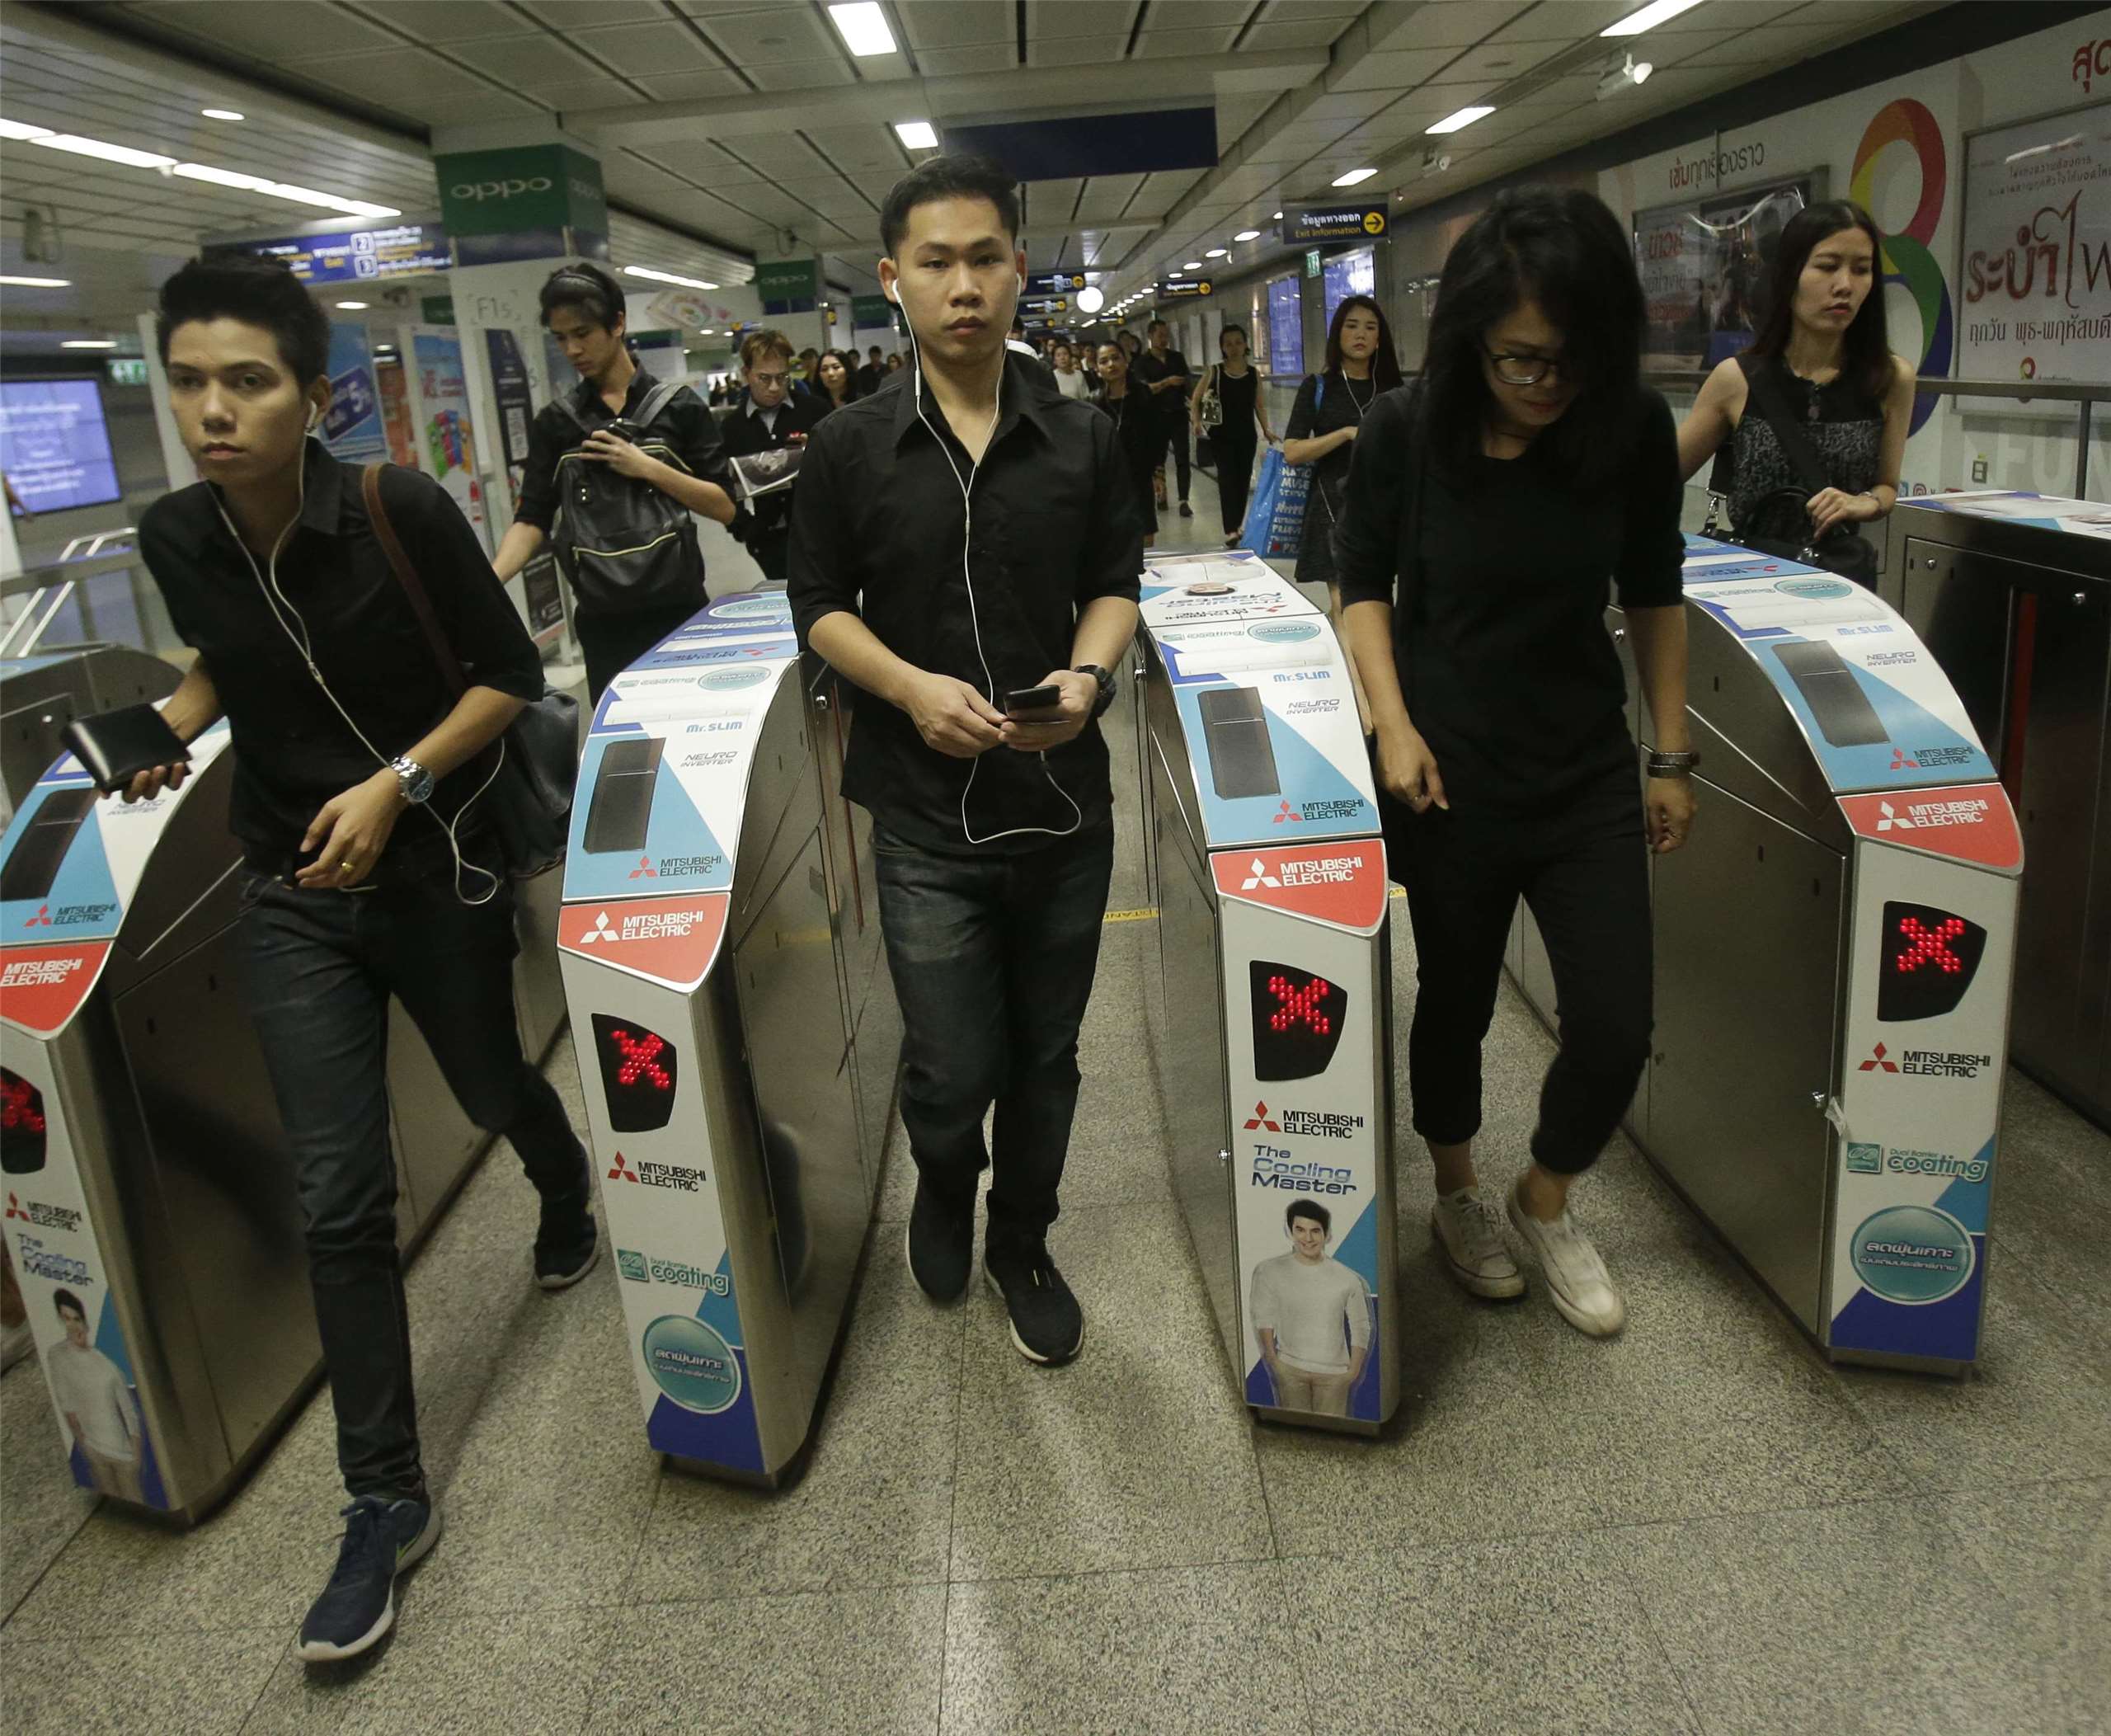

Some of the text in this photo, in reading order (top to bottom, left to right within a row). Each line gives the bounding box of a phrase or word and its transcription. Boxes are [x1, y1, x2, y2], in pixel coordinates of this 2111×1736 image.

[450, 176, 552, 201] oppo
[1970, 318, 2006, 347] ทุกวัน
[1866, 651, 1916, 661] NEURO
[1288, 699, 1340, 708] NEURO
[684, 750, 738, 761] NEURO
[1913, 746, 1974, 758] MITSUBISHI
[1919, 756, 1970, 768] ELECTRIC
[1302, 799, 1364, 812] MITSUBISHI
[1907, 798, 1988, 816] MITSUBISHI
[1304, 808, 1358, 821] ELECTRIC
[1912, 812, 1984, 828] ELECTRIC
[661, 855, 722, 868] MITSUBISHI
[1280, 856, 1363, 875] MITSUBISHI
[660, 864, 712, 877] ELECTRIC
[1283, 870, 1354, 887] ELECTRIC
[57, 904, 116, 915] MITSUBISHI
[53, 913, 105, 924] ELECTRIC
[623, 910, 703, 928] MITSUBISHI
[622, 924, 691, 940] ELECTRIC
[4, 958, 83, 975] MITSUBISHI
[0, 972, 68, 987] ELECTRIC
[1903, 1051, 1991, 1066] MITSUBISHI
[1903, 1063, 1977, 1079] ELECTRIC
[1283, 1110, 1364, 1127] MITSUBISHI
[1284, 1122, 1352, 1139] ELECTRIC
[1253, 1145, 1291, 1159] The
[637, 1160, 706, 1181] MITSUBISHI
[1253, 1157, 1352, 1183] Cooling
[1888, 1154, 1987, 1181] coating
[641, 1174, 698, 1192] ELECTRIC
[1252, 1172, 1356, 1195] Master
[23, 1259, 94, 1287] Master
[651, 1265, 729, 1295] coating
